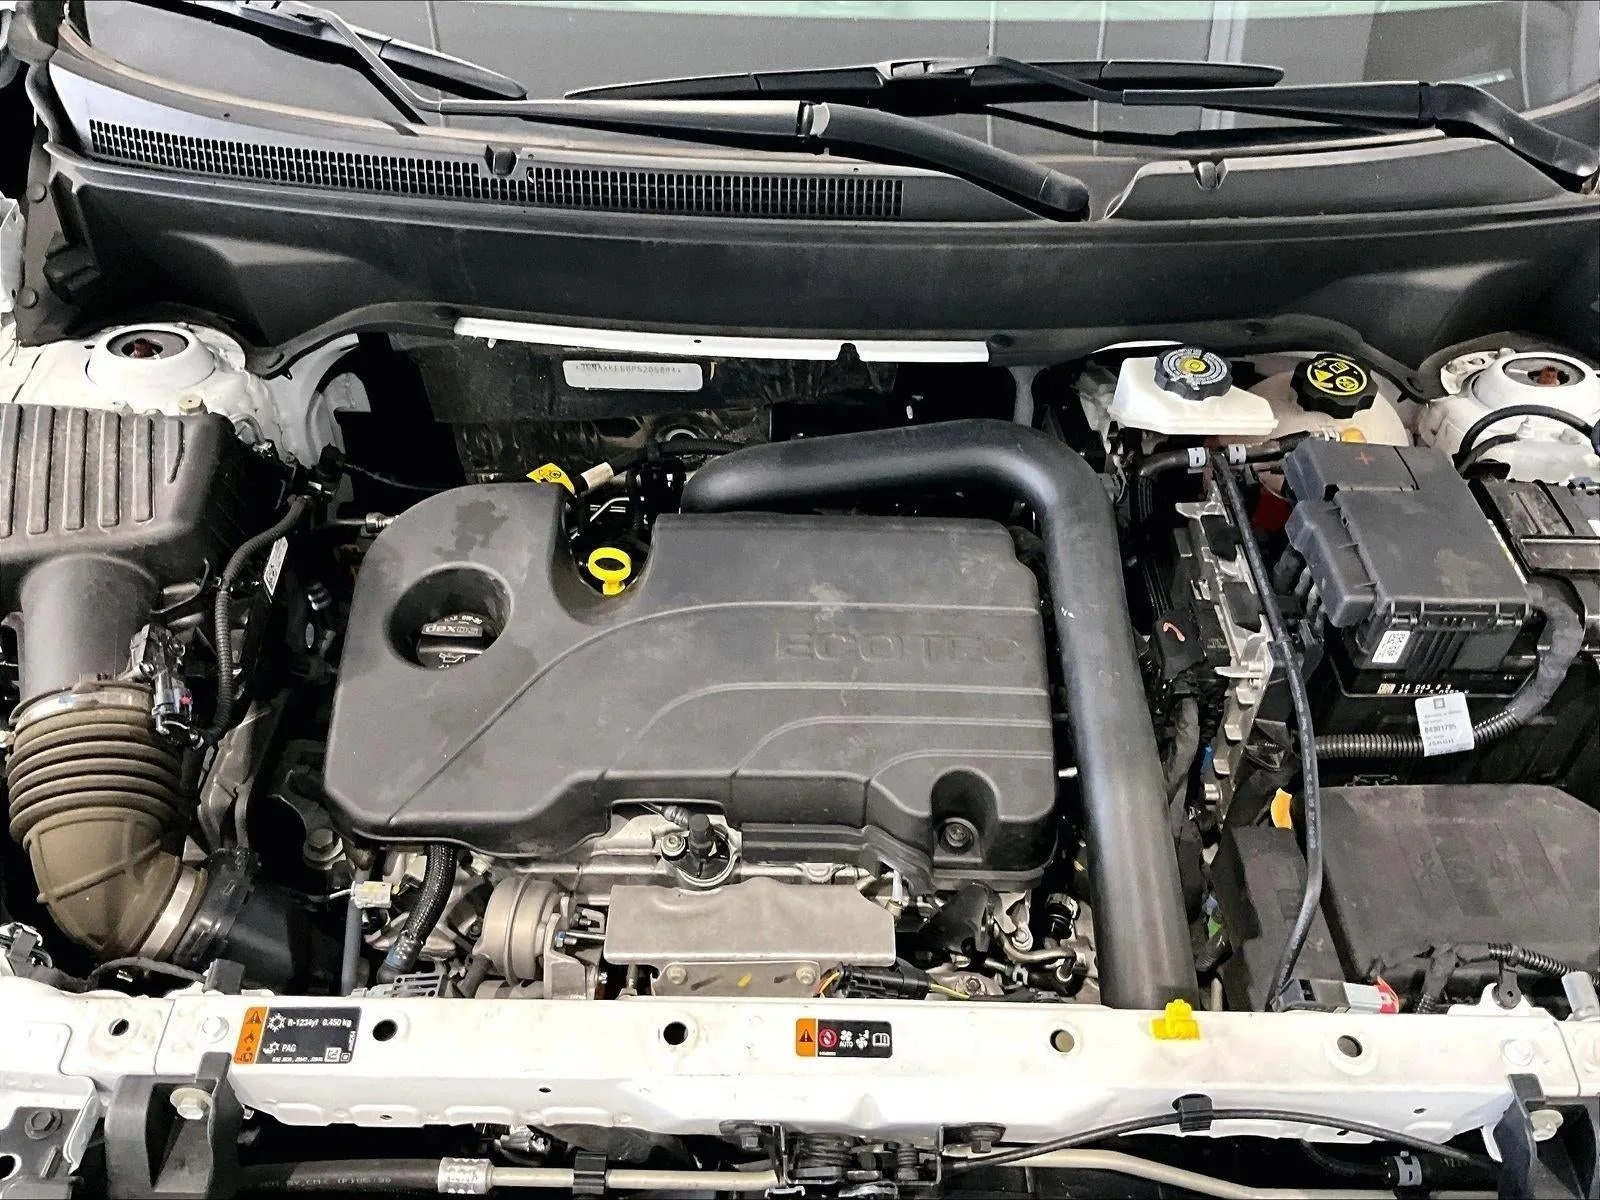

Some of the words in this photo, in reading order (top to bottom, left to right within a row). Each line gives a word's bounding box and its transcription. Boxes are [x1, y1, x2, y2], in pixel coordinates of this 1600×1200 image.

[425, 623, 479, 635] dexos
[287, 1018, 320, 1028] R-1234yf
[342, 1018, 352, 1028] kg
[281, 1043, 297, 1053] PAG
[839, 1040, 854, 1048] AUTO
